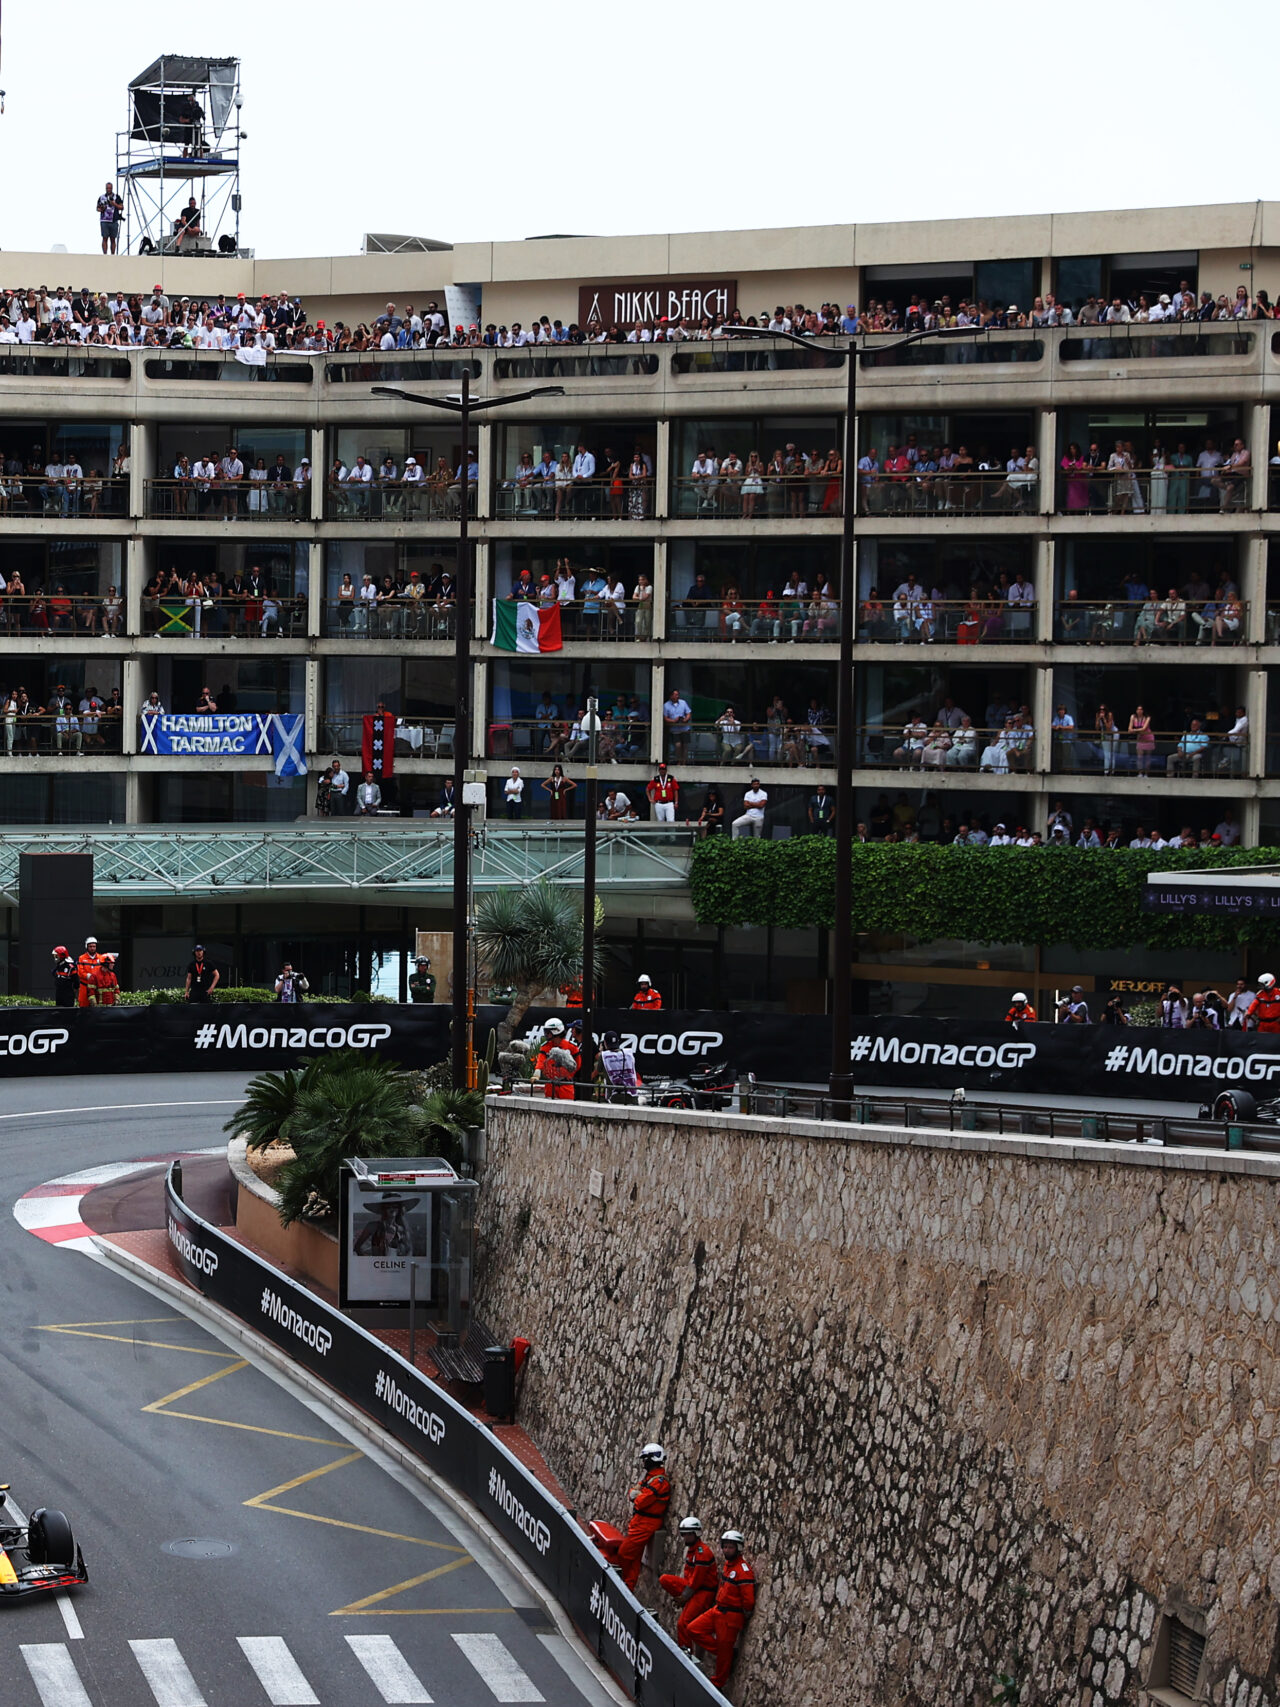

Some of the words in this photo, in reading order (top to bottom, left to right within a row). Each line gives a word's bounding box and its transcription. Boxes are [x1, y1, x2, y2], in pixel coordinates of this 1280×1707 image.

[614, 291, 660, 323] NIKKI
[667, 288, 728, 321] BEACH
[161, 715, 253, 733] HAMILTON
[168, 736, 245, 753] TARMAC
[1160, 893, 1197, 905] LILLY'S
[1215, 895, 1253, 907] LILLY'S
[1110, 980, 1166, 993] XERJOFF
[373, 1260, 407, 1270] CELINE
